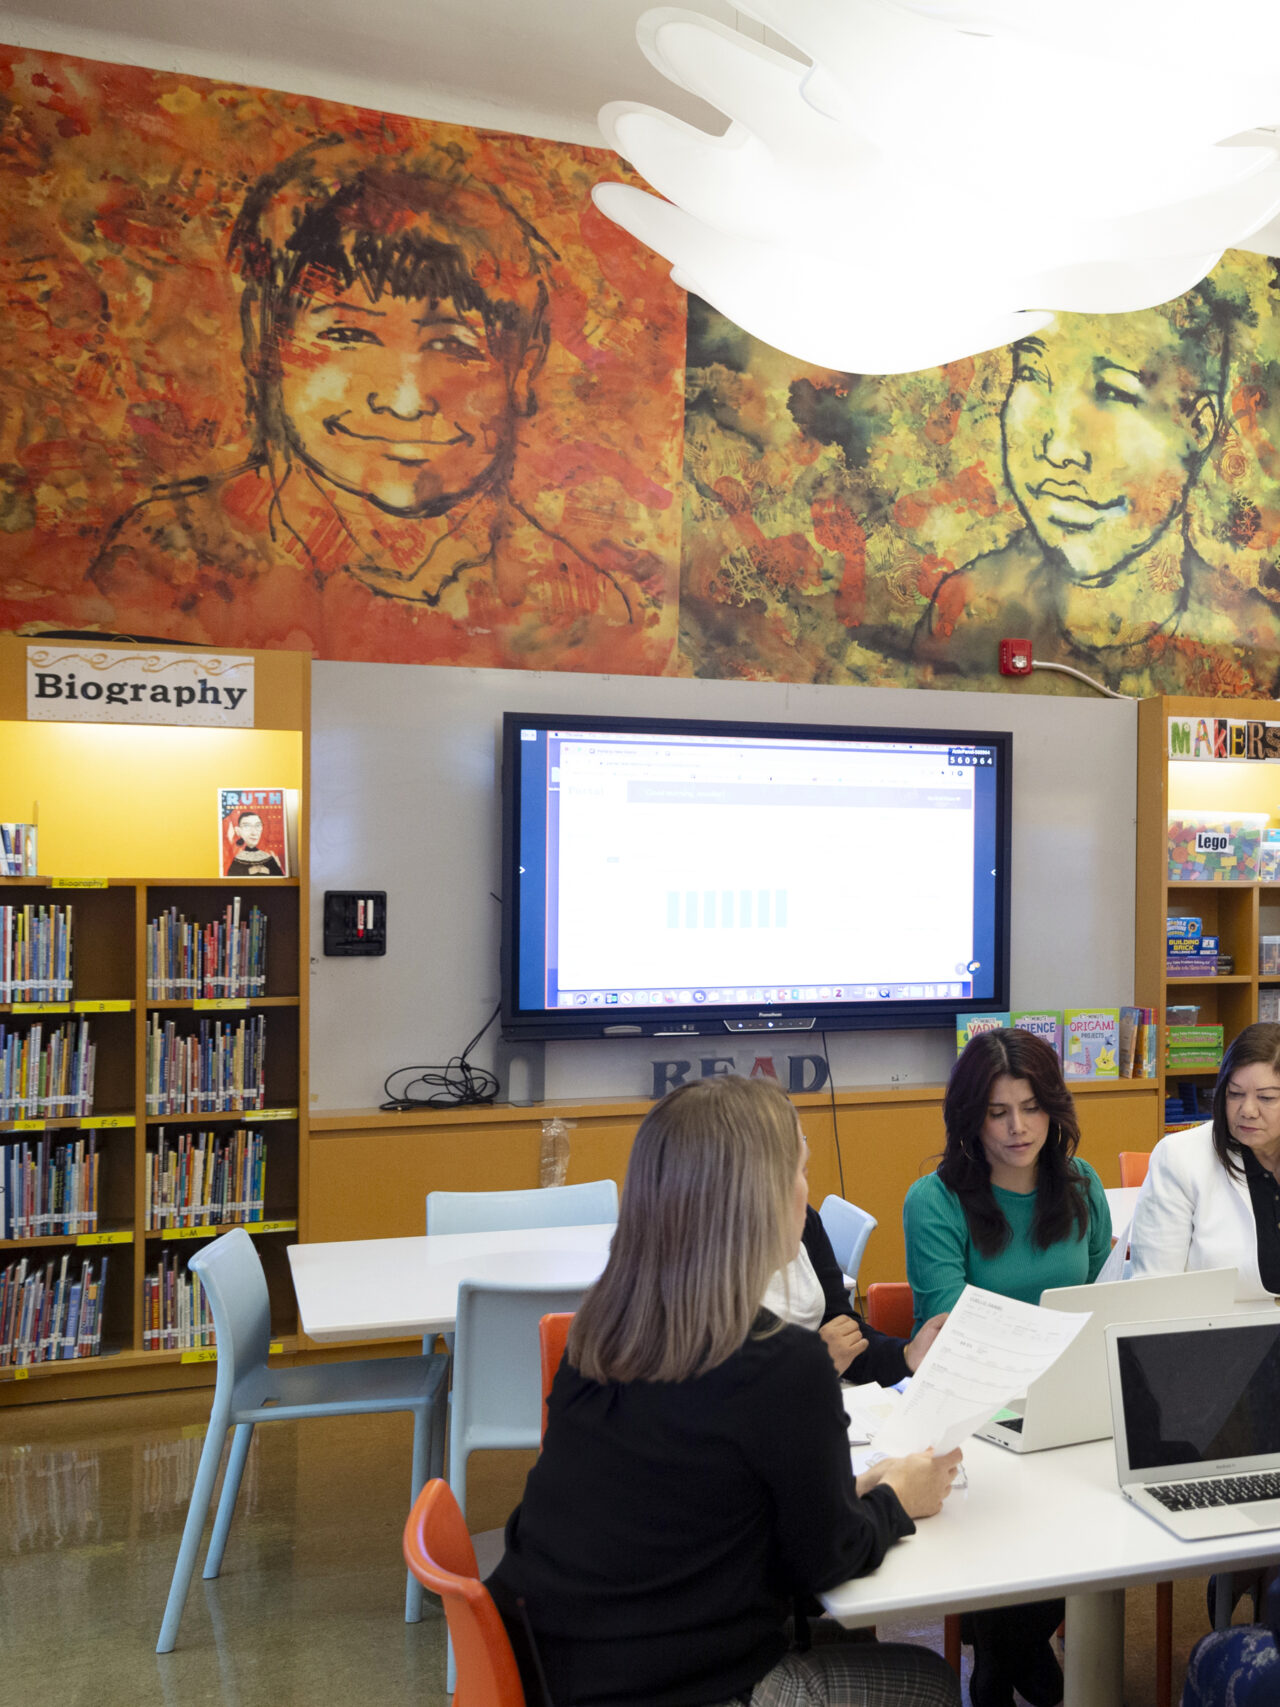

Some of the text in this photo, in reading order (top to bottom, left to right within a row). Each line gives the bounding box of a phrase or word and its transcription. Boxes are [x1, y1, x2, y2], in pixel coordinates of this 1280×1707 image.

[35, 673, 247, 710] Biography
[950, 756, 993, 765] 560964
[226, 792, 282, 806] RUTH
[1196, 834, 1228, 851] Lego
[58, 878, 105, 889] Biography
[1014, 1022, 1056, 1034] SCIENCE
[1070, 1020, 1115, 1032] ORIGAMI
[650, 1054, 829, 1100] READ
[100, 1119, 118, 1128] F-G
[179, 1229, 198, 1237] L-M
